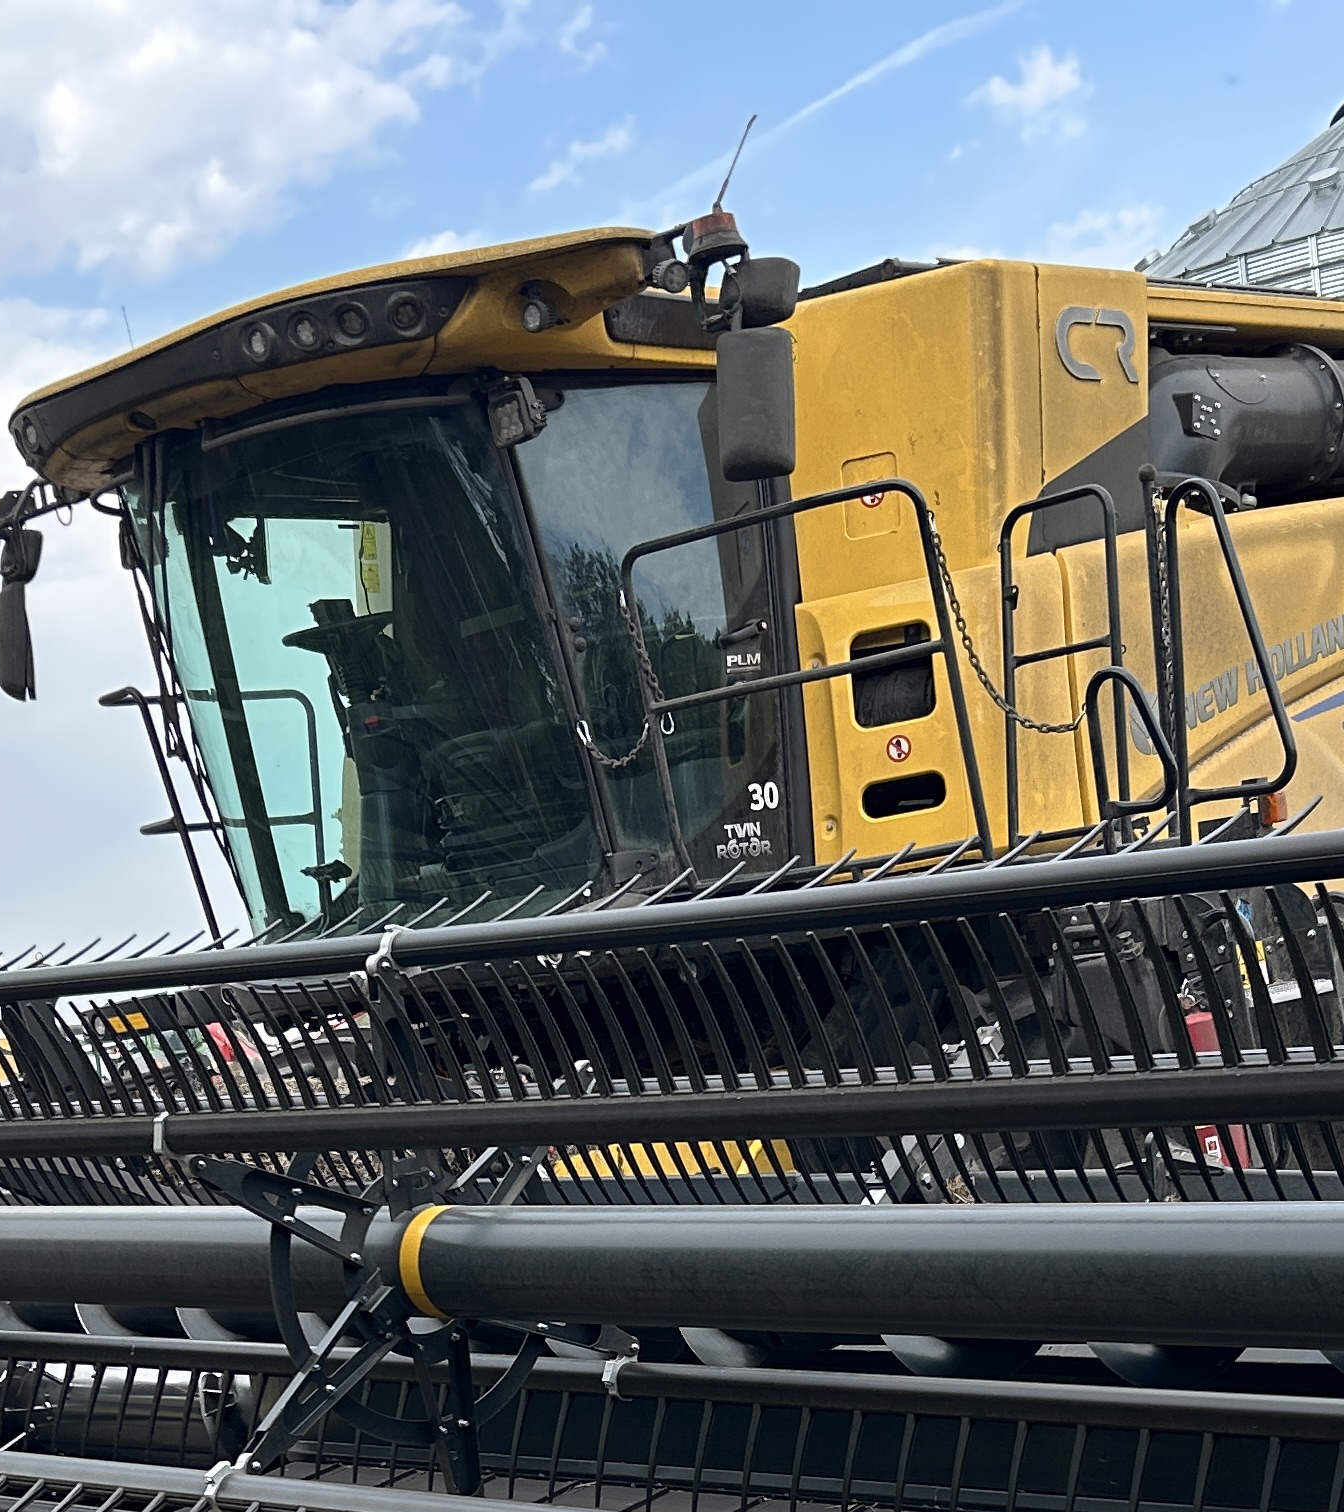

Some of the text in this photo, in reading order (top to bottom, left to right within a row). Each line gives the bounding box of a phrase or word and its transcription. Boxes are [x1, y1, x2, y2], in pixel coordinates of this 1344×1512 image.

[1055, 306, 1139, 384] CR
[726, 652, 761, 667] PLM
[747, 781, 779, 811] 30
[723, 821, 761, 839] TWIN
[716, 837, 773, 859] ROTOR
